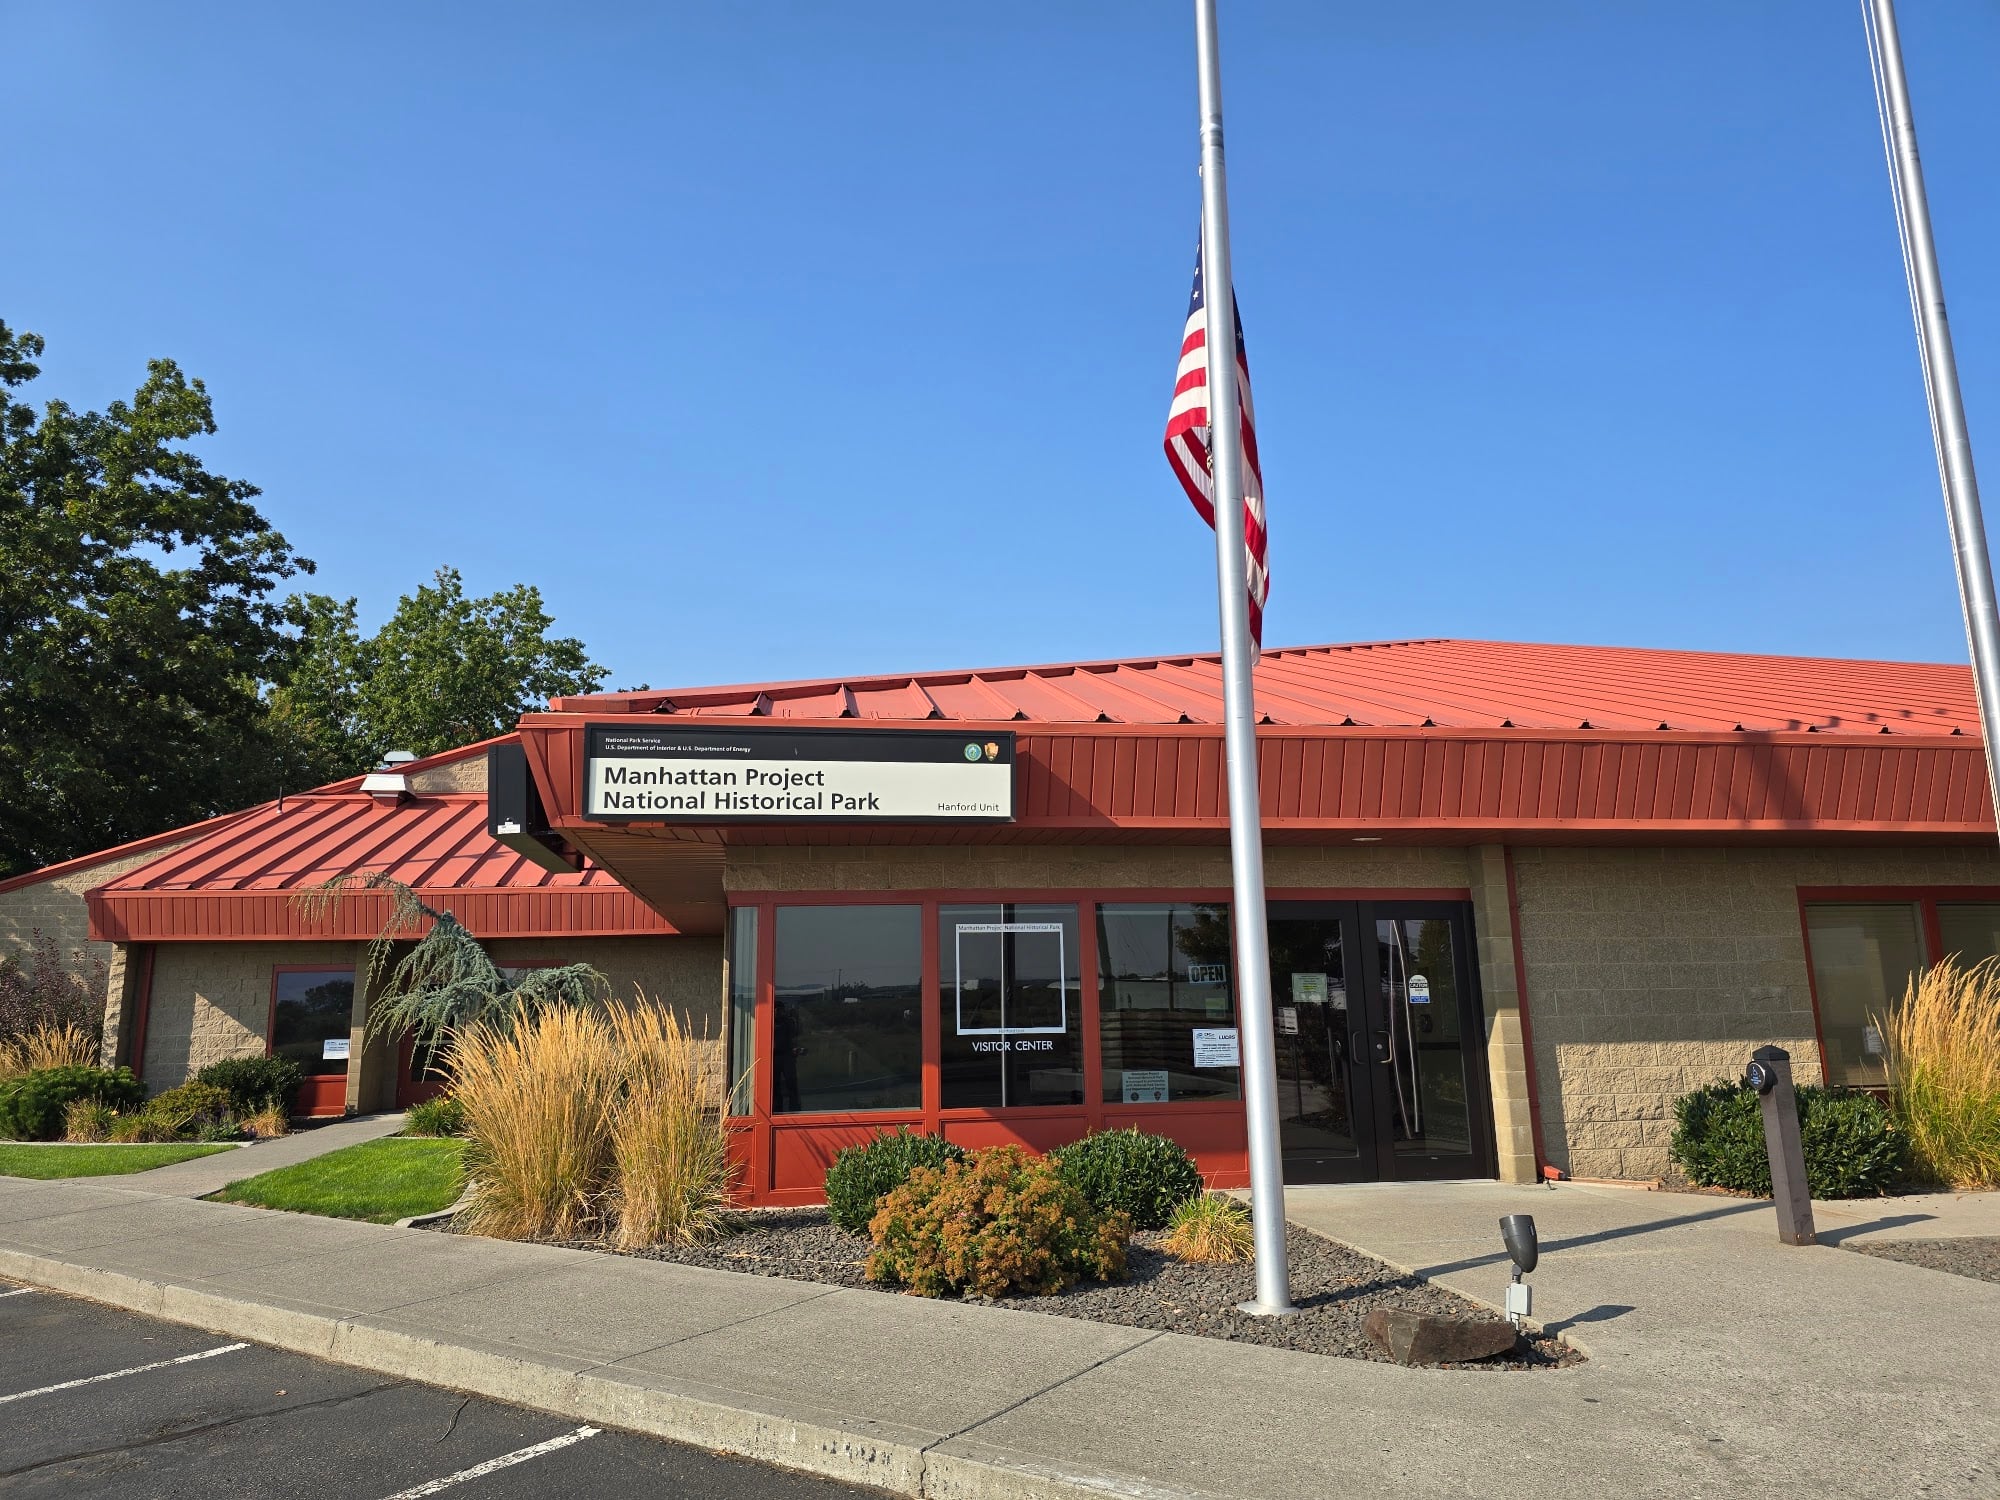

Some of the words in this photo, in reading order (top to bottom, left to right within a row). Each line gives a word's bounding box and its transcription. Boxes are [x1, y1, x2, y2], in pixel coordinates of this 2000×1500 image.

[604, 766, 736, 786] Manhattan
[746, 768, 825, 790] Project
[603, 791, 705, 810] National
[715, 791, 822, 810] Historical
[831, 792, 880, 811] Park
[938, 802, 977, 811] Hanford
[979, 803, 1000, 812] Unit
[1191, 965, 1224, 982] OPEN
[972, 1041, 1011, 1052] VISITOR
[1015, 1040, 1054, 1051] CENTER
